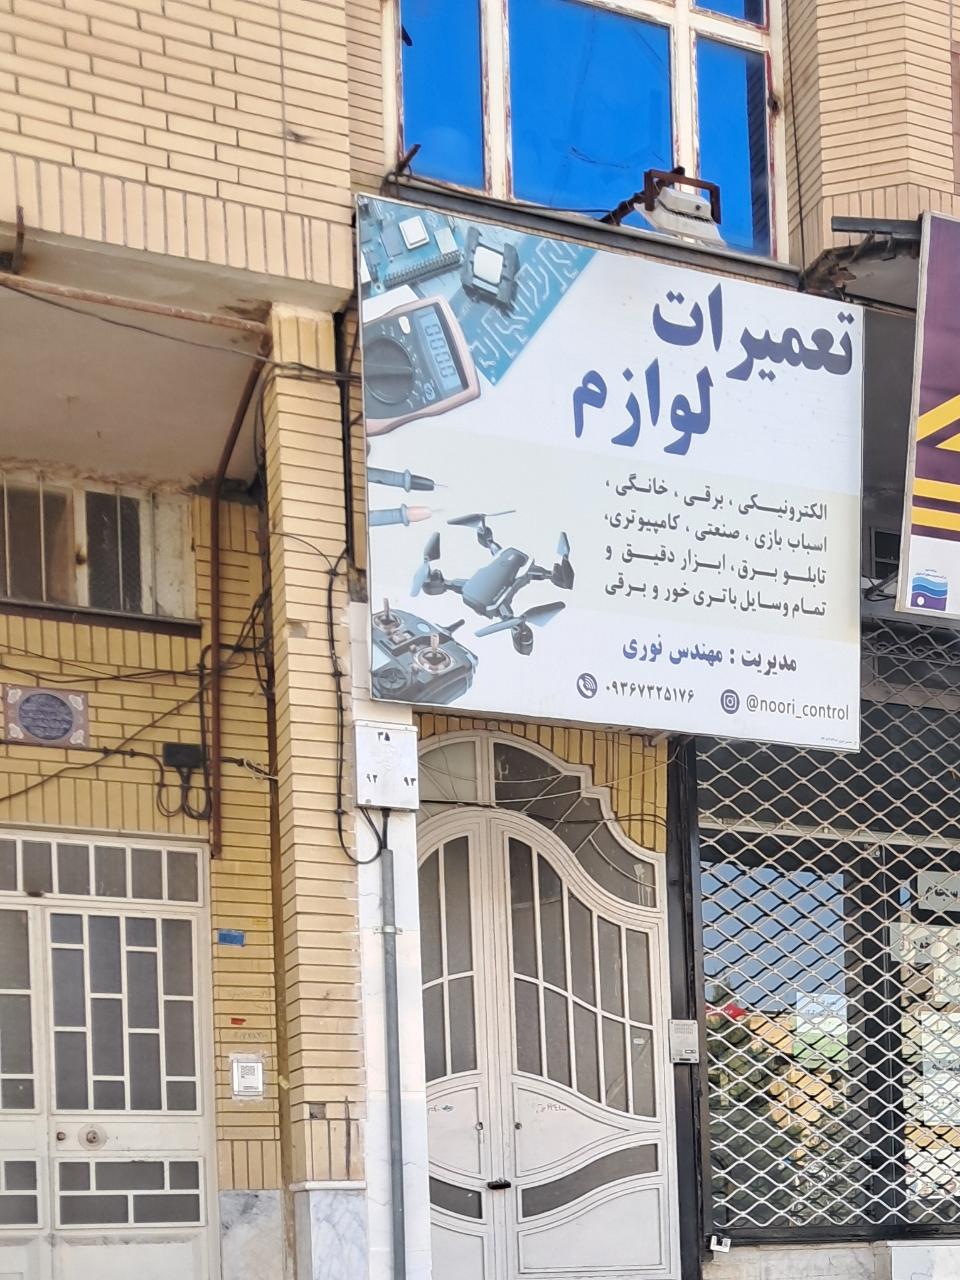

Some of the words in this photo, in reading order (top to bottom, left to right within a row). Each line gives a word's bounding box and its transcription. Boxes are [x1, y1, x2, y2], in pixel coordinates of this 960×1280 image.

[652, 283, 855, 381] تعمیرات
[572, 357, 714, 455] لوازم
[616, 474, 668, 496] خانگی
[684, 485, 724, 510] برقی
[738, 494, 827, 522] الکترونیکی
[695, 523, 740, 541] صنعتی
[754, 528, 782, 550] بازی
[787, 533, 827, 555] اسباب
[622, 543, 675, 566] دقیق
[681, 548, 725, 573] ابزار
[605, 572, 646, 596] برقی
[782, 567, 826, 588] تابلو
[664, 580, 690, 602] خور
[693, 587, 737, 610] باتری
[740, 590, 788, 616] وسایل
[791, 597, 826, 618] تمام
[622, 634, 663, 662] نوری
[669, 643, 723, 666] مهندس
[741, 651, 797, 676] مدیریت
[606, 680, 694, 704] ۰۹۳۶۷۳۲۵۱۷۶
[746, 694, 850, 720] @noori_control
